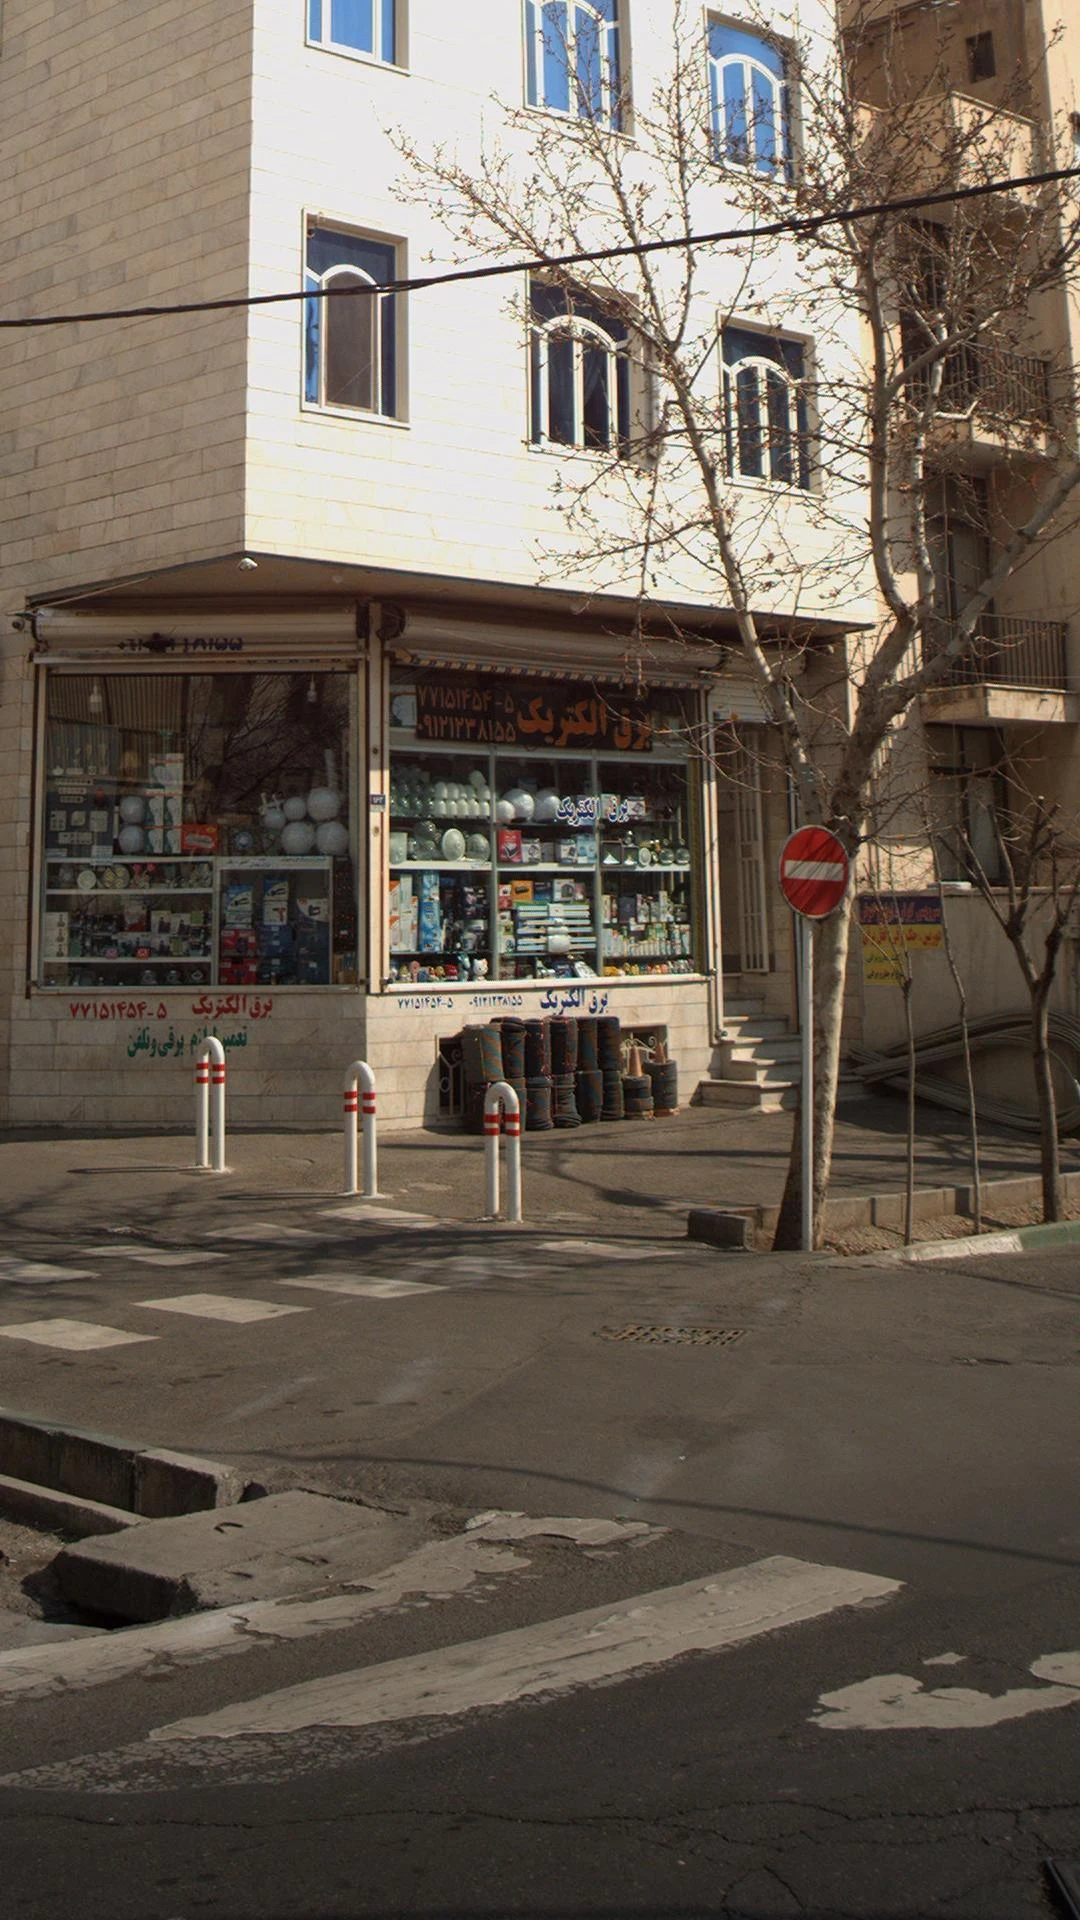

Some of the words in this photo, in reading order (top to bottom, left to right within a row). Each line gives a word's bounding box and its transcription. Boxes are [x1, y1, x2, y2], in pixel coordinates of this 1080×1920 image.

[417, 685, 514, 714] ۷۷۱۵۱۴۵۴-۵
[517, 697, 607, 747] الکتریک
[614, 709, 653, 750] برق
[556, 796, 601, 827] الکتریک
[608, 796, 630, 823] برق
[69, 1001, 168, 1021] ۷۷۱۵۱۴۵۴-۵
[191, 994, 246, 1019] الکتریک
[249, 995, 274, 1020] برق
[397, 996, 454, 1009] ۷۷۱۵۱۴۵۴-۵
[540, 988, 586, 1016] الکتریک
[588, 990, 609, 1014] برق
